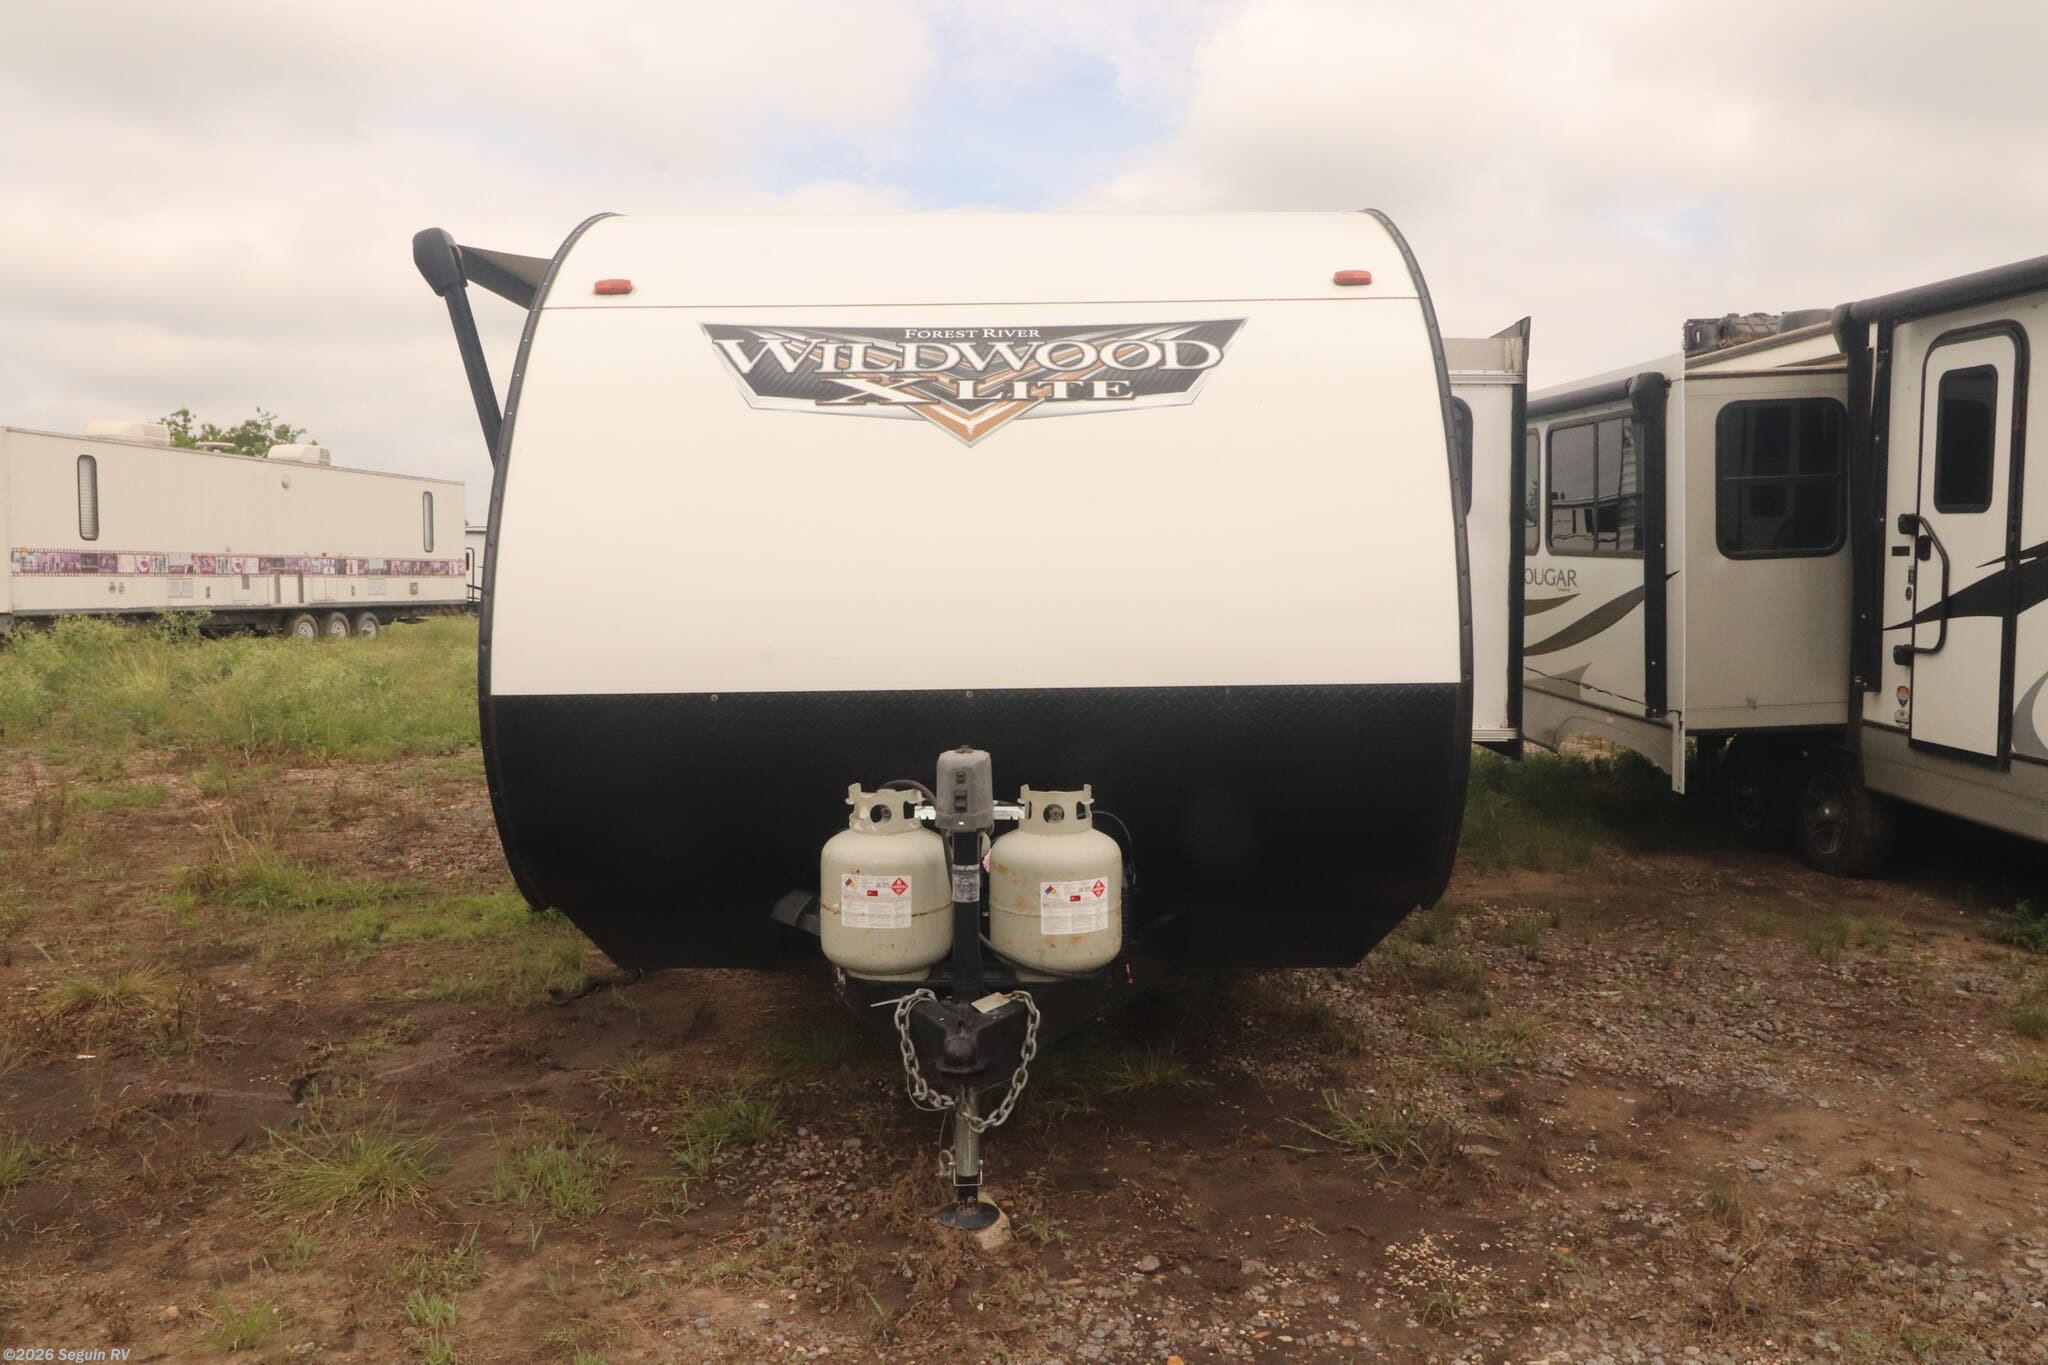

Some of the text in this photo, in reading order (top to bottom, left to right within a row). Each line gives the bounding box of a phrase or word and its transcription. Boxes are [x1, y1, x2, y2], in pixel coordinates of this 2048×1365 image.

[904, 327, 1041, 339] FOREST RIVER
[711, 337, 1225, 375] WILDWOOD
[815, 376, 1136, 407] X LITE
[1524, 567, 1578, 588] OUGAR
